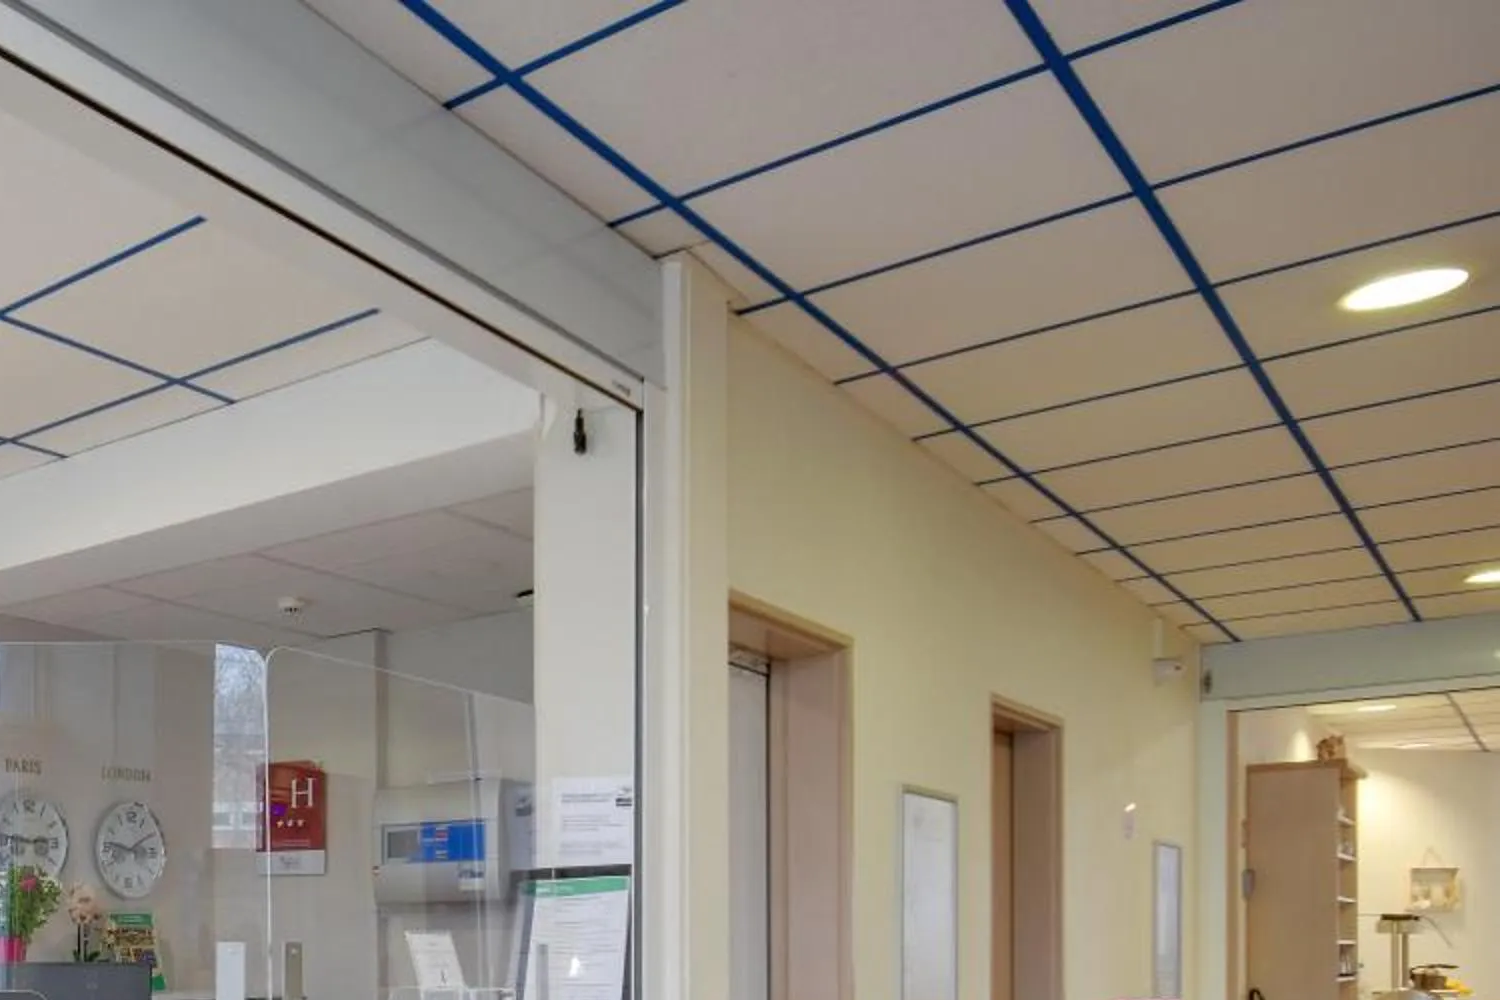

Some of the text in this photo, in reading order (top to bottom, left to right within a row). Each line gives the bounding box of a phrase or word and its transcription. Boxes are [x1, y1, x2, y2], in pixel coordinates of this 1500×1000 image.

[5, 758, 42, 776] PARIS
[101, 765, 151, 782] LONDON
[291, 777, 313, 809] H
